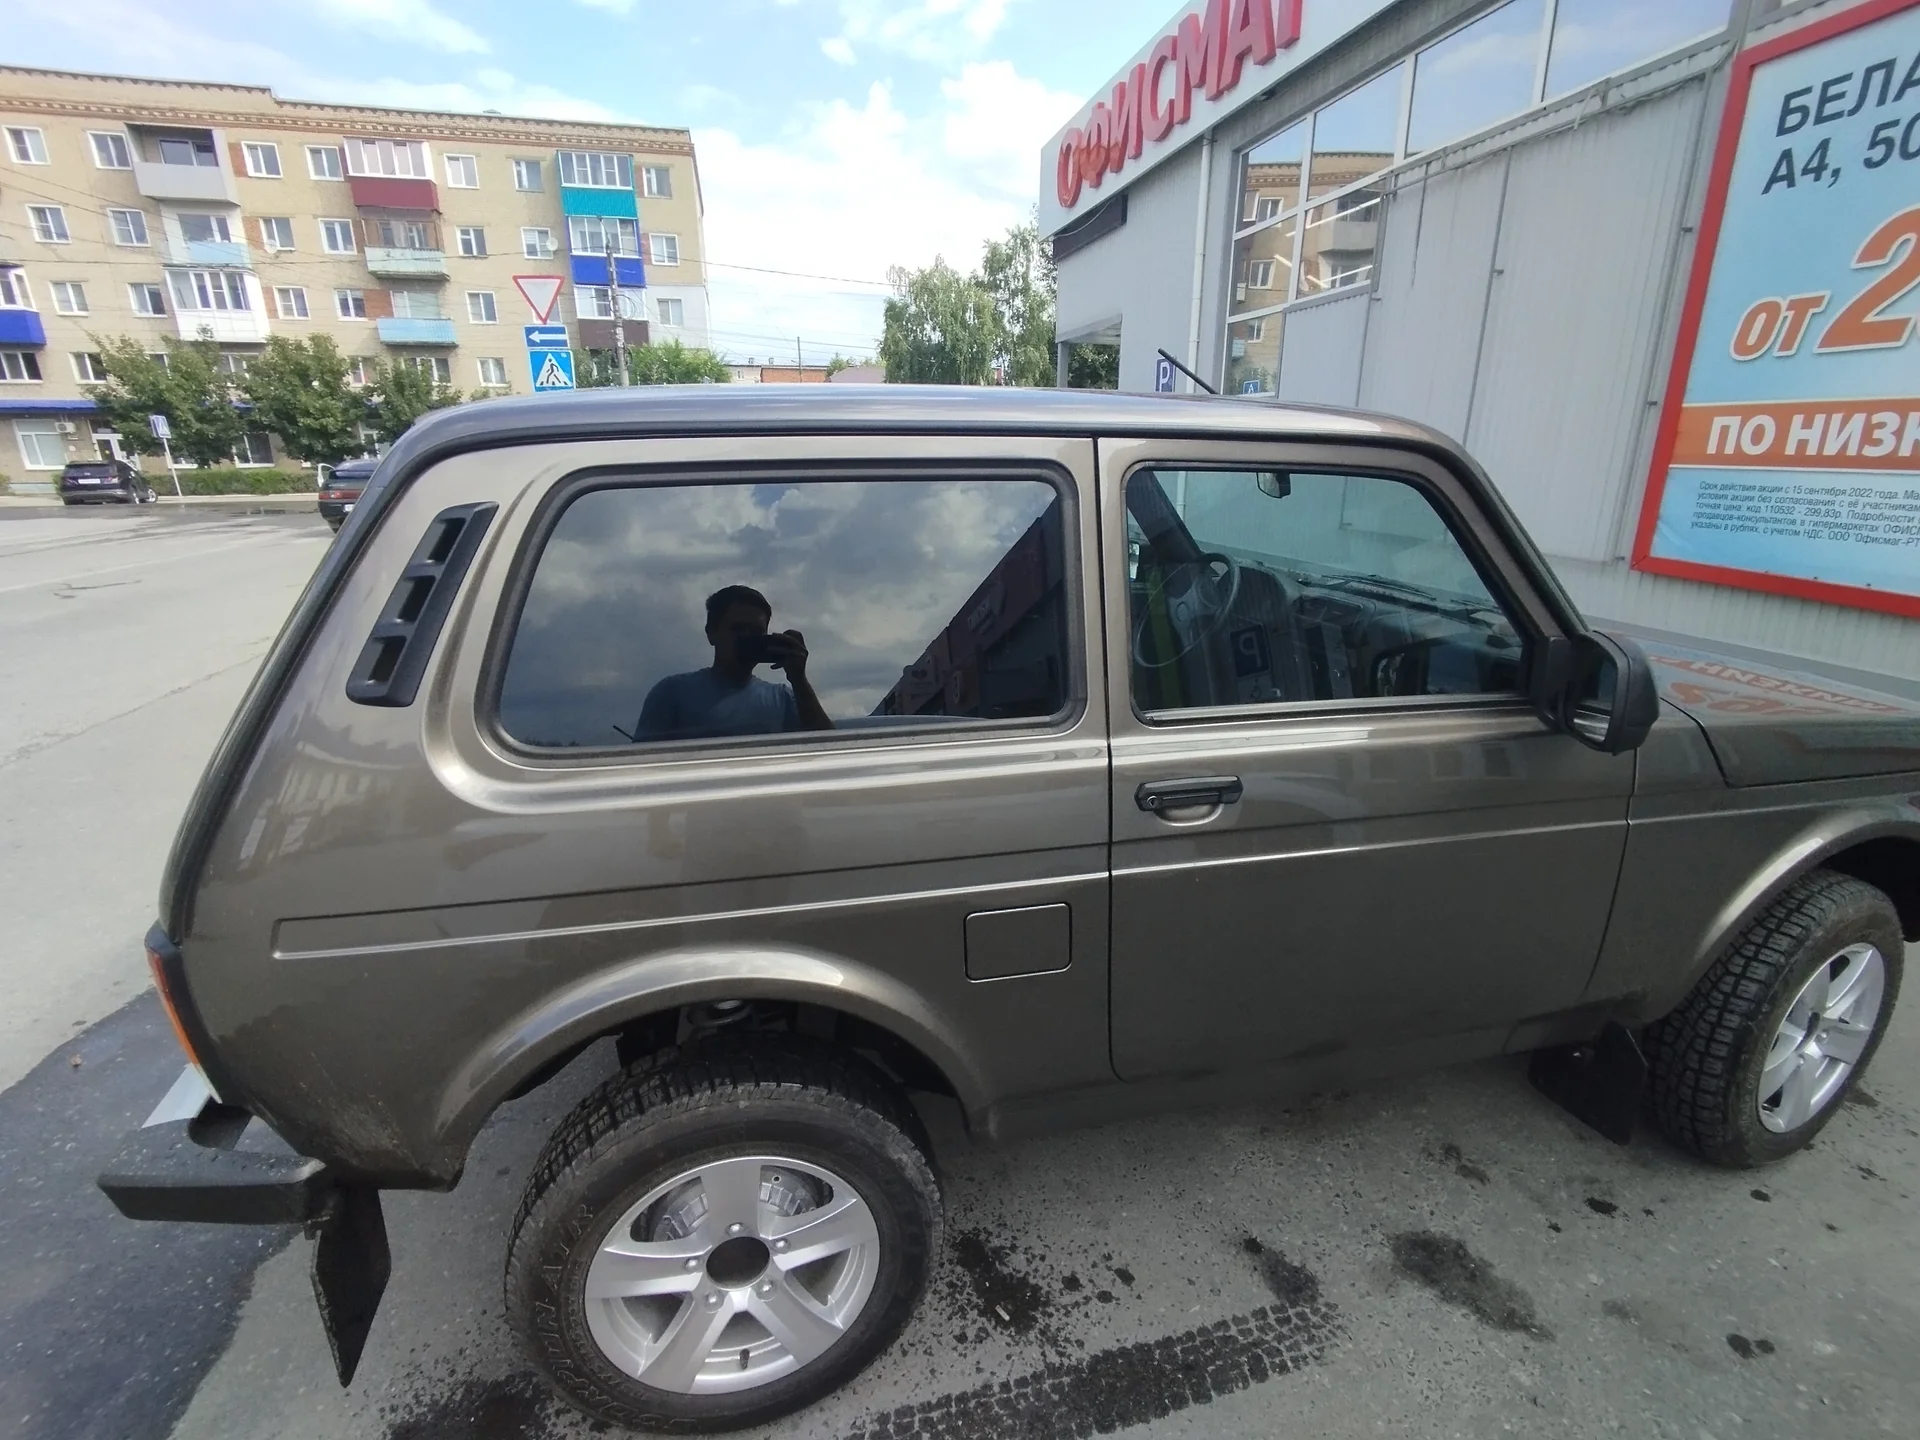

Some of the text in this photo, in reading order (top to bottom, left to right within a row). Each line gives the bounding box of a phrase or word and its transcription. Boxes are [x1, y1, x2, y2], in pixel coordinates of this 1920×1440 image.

[1706, 414, 1777, 456] ПО
[1700, 481, 1718, 491] Срок
[1719, 483, 1757, 492] действия
[1757, 485, 1783, 493] акции
[1793, 485, 1803, 494] 15
[1804, 486, 1847, 498] сентября
[1848, 487, 1873, 498] 2022
[1697, 492, 1729, 500] условия
[1730, 494, 1756, 502] акции
[1757, 494, 1773, 503] без
[1774, 496, 1836, 507] согласования
[1696, 501, 1721, 509] точная
[1746, 505, 1762, 514] код
[1765, 505, 1796, 515] 110532
[1847, 509, 1915, 523] Подробности
[1690, 521, 1722, 530] указаны
[1770, 527, 1801, 537] учетом
[1827, 530, 1850, 541] ООО
[1808, 520, 1880, 533] гипермаркетах
